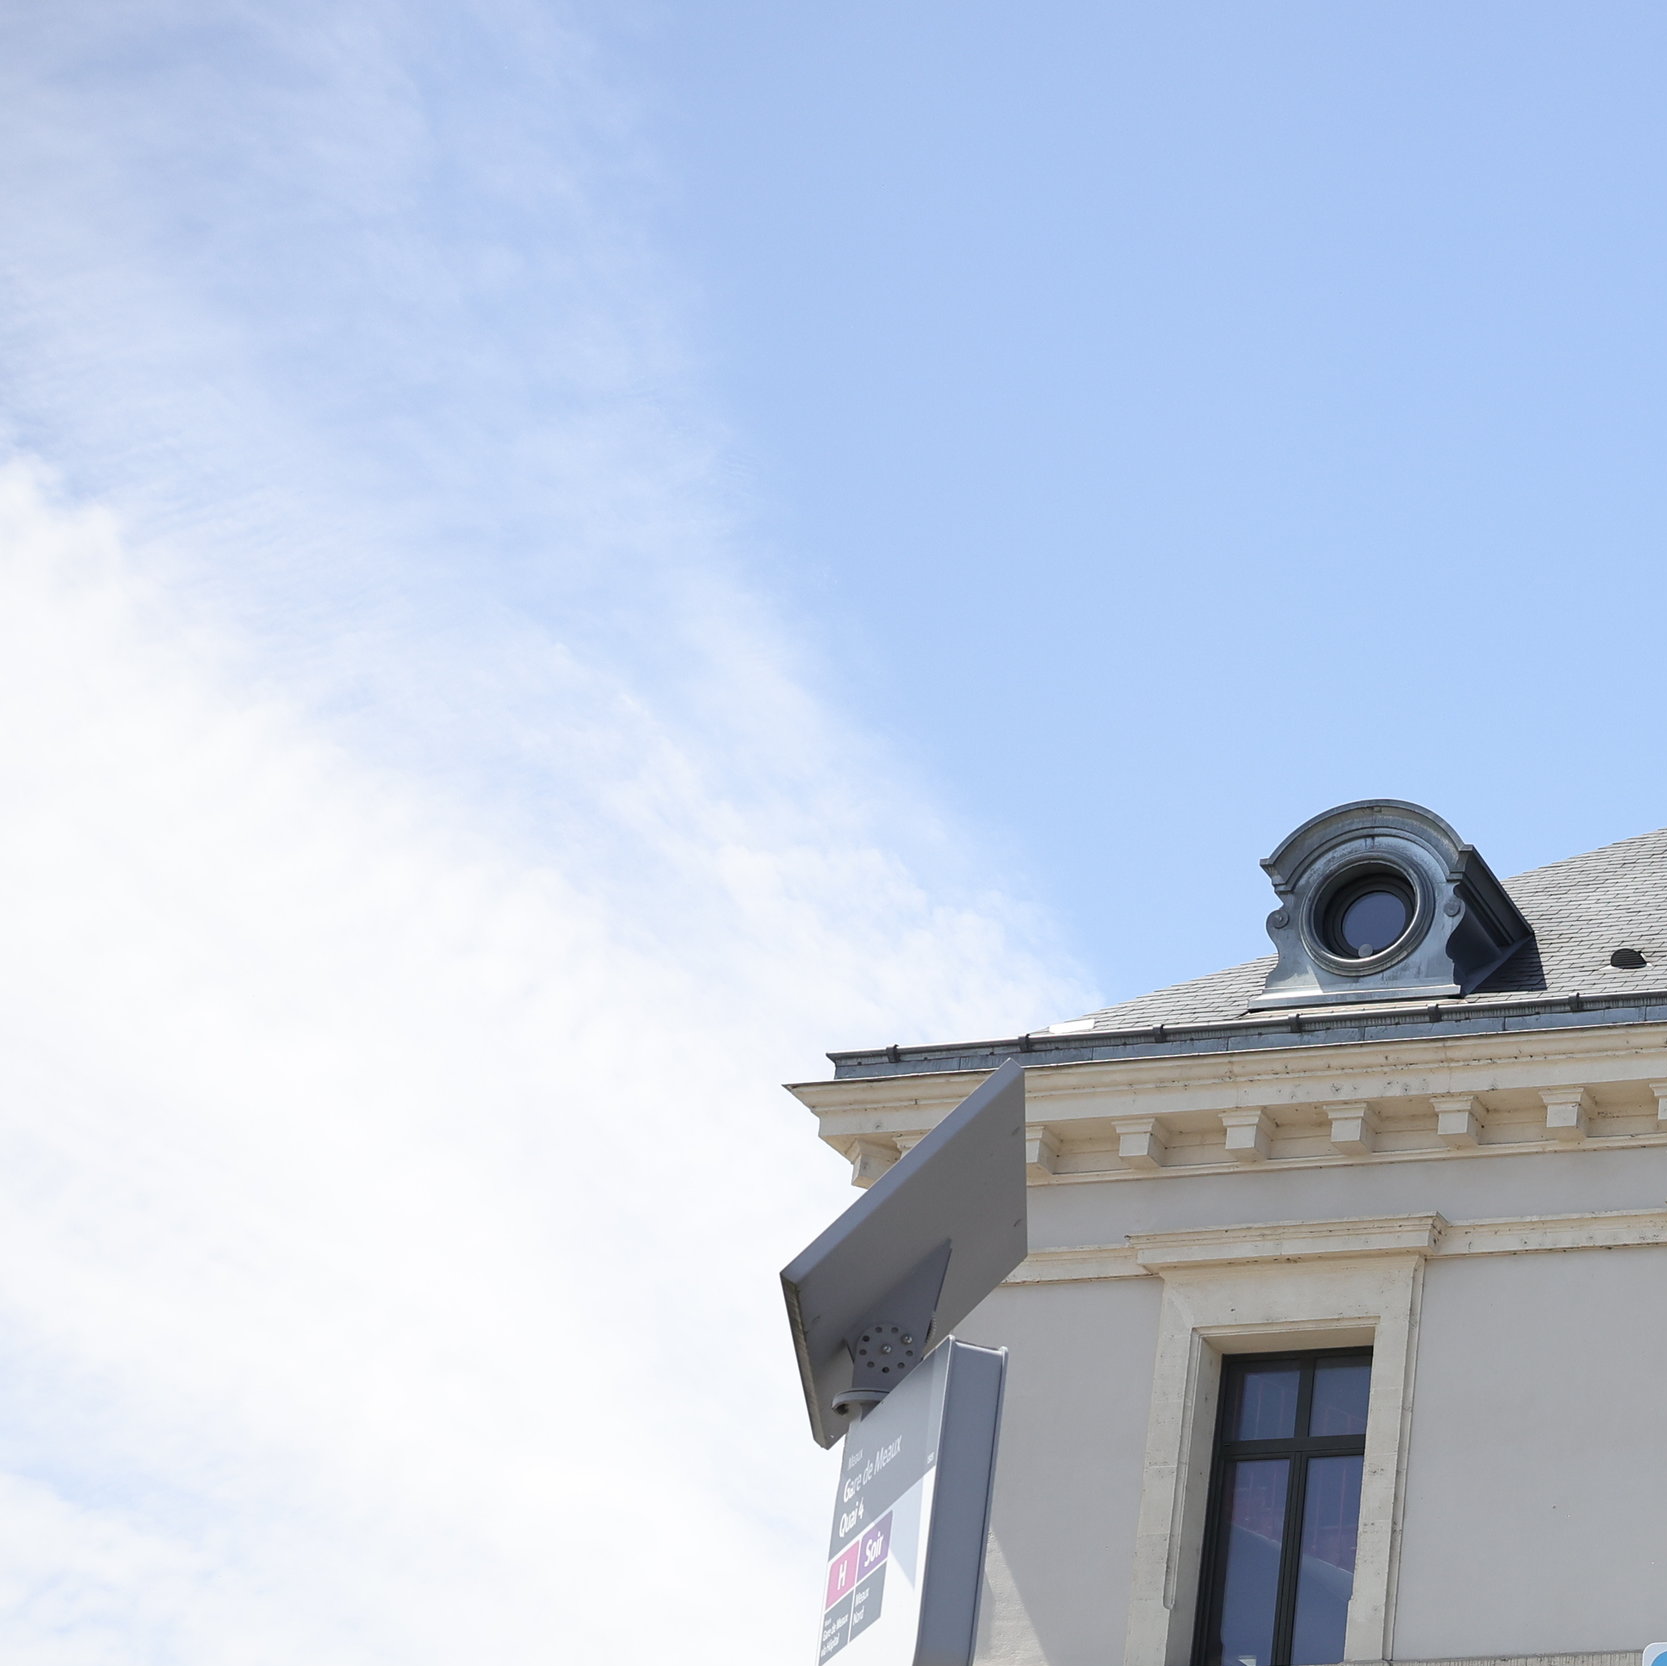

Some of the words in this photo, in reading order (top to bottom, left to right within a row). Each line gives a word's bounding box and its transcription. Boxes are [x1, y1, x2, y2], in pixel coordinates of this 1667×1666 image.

[843, 1473, 862, 1503] Gare
[863, 1459, 874, 1485] de
[874, 1434, 902, 1476] Meaux
[847, 1448, 864, 1471] Meaux
[839, 1500, 859, 1538] Quai
[858, 1497, 865, 1520] 4
[864, 1530, 884, 1567] Soir
[837, 1560, 848, 1591] H
